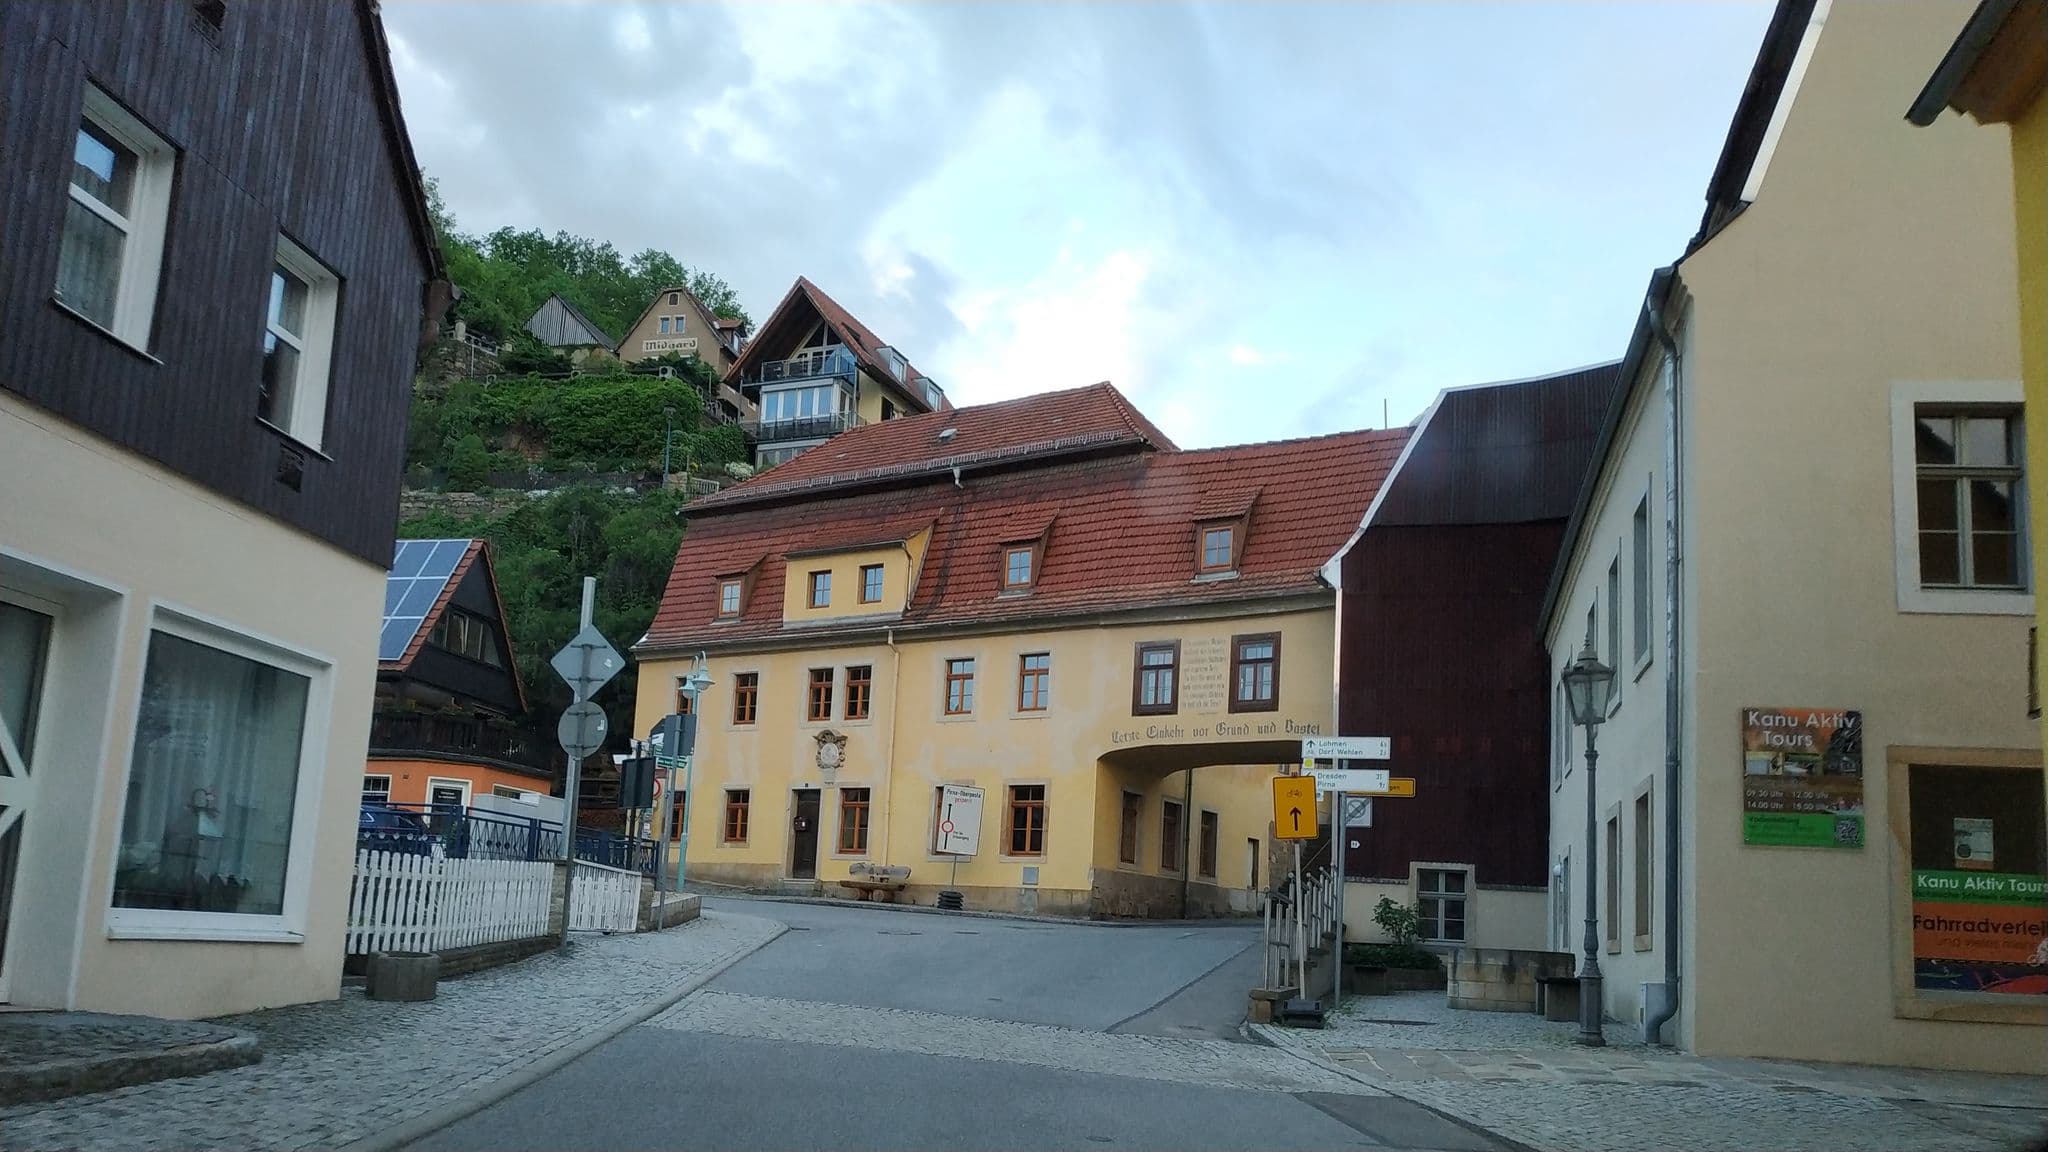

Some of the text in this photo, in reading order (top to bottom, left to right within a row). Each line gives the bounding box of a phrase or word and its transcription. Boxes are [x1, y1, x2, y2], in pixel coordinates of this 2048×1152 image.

[1748, 711, 1855, 728] Kanu Aktiv
[1193, 726, 1209, 737] vor
[1215, 720, 1250, 737] Grund
[1258, 720, 1276, 735] und
[1763, 731, 1813, 747] Tours
[1317, 772, 1347, 780] Dresden
[1917, 874, 1959, 889] Kanu
[1964, 877, 2004, 891] Aktiv
